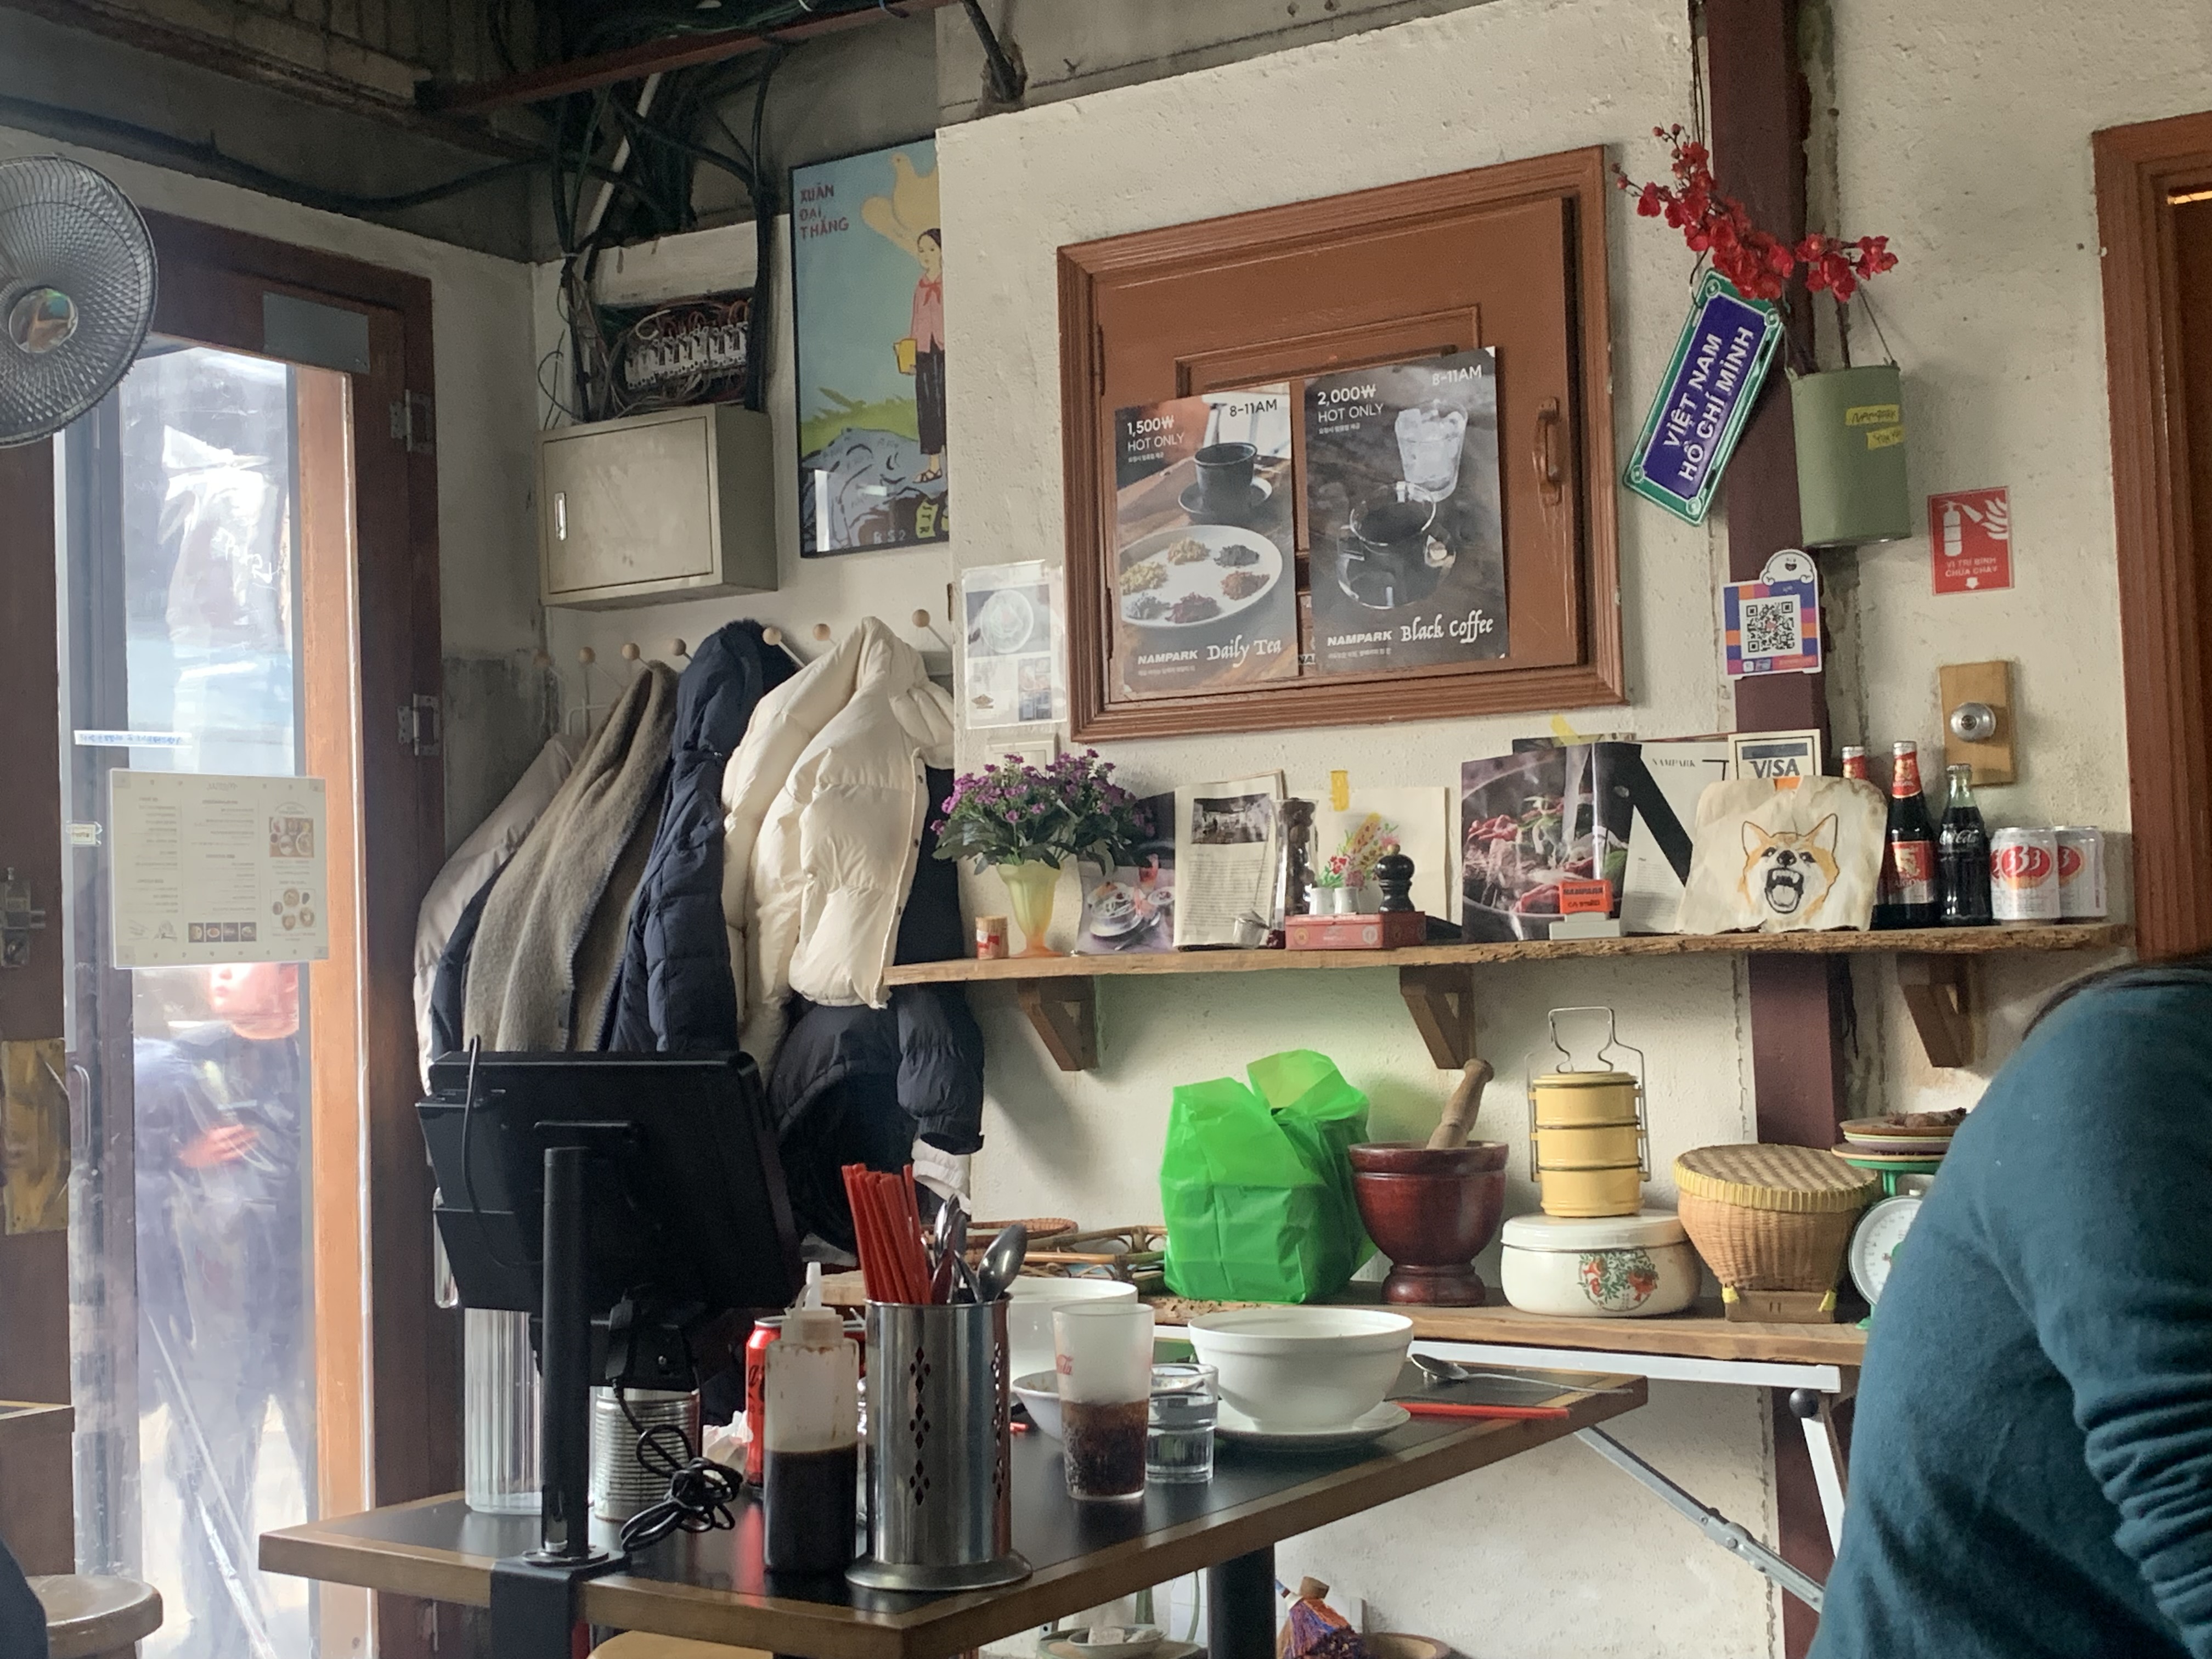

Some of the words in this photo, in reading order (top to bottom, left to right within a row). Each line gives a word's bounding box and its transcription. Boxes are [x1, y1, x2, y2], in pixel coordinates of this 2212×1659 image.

[1689, 334, 1723, 392] NAM
[1432, 364, 1482, 385] 8-11AM
[1229, 399, 1278, 417] 8-11AM
[1318, 408, 1345, 423] HOT
[1349, 403, 1384, 419] ONLY
[1696, 394, 1726, 439] CHÍ
[1127, 437, 1152, 452] HOT
[1154, 432, 1185, 448] ONLY
[1328, 630, 1393, 646] NAMPARK
[1400, 613, 1444, 642] Black
[1449, 609, 1494, 644] Coffee
[1137, 650, 1199, 665] NAMPARK
[1206, 634, 1250, 668] Daily
[1254, 639, 1282, 656] Tea
[1750, 758, 1800, 778] VISA
